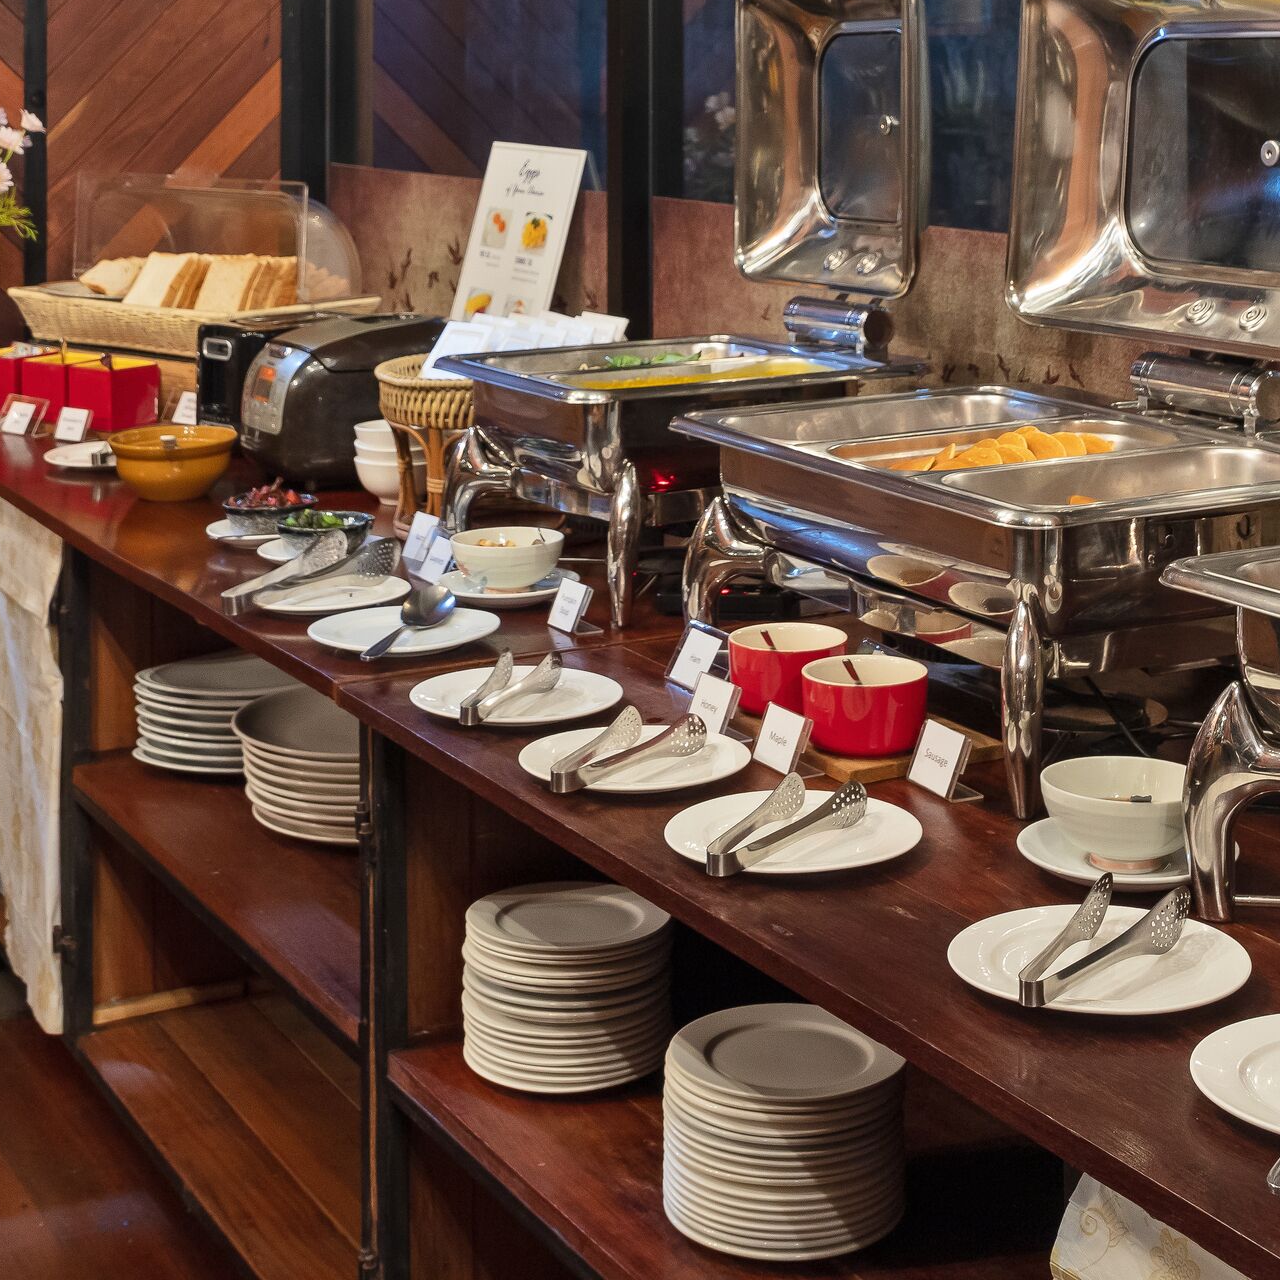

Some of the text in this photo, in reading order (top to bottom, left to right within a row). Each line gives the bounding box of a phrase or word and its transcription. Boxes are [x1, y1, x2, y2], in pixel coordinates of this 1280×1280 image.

[700, 699, 719, 715] Honey
[770, 730, 788, 747] Maple
[924, 747, 949, 768] Sausage
